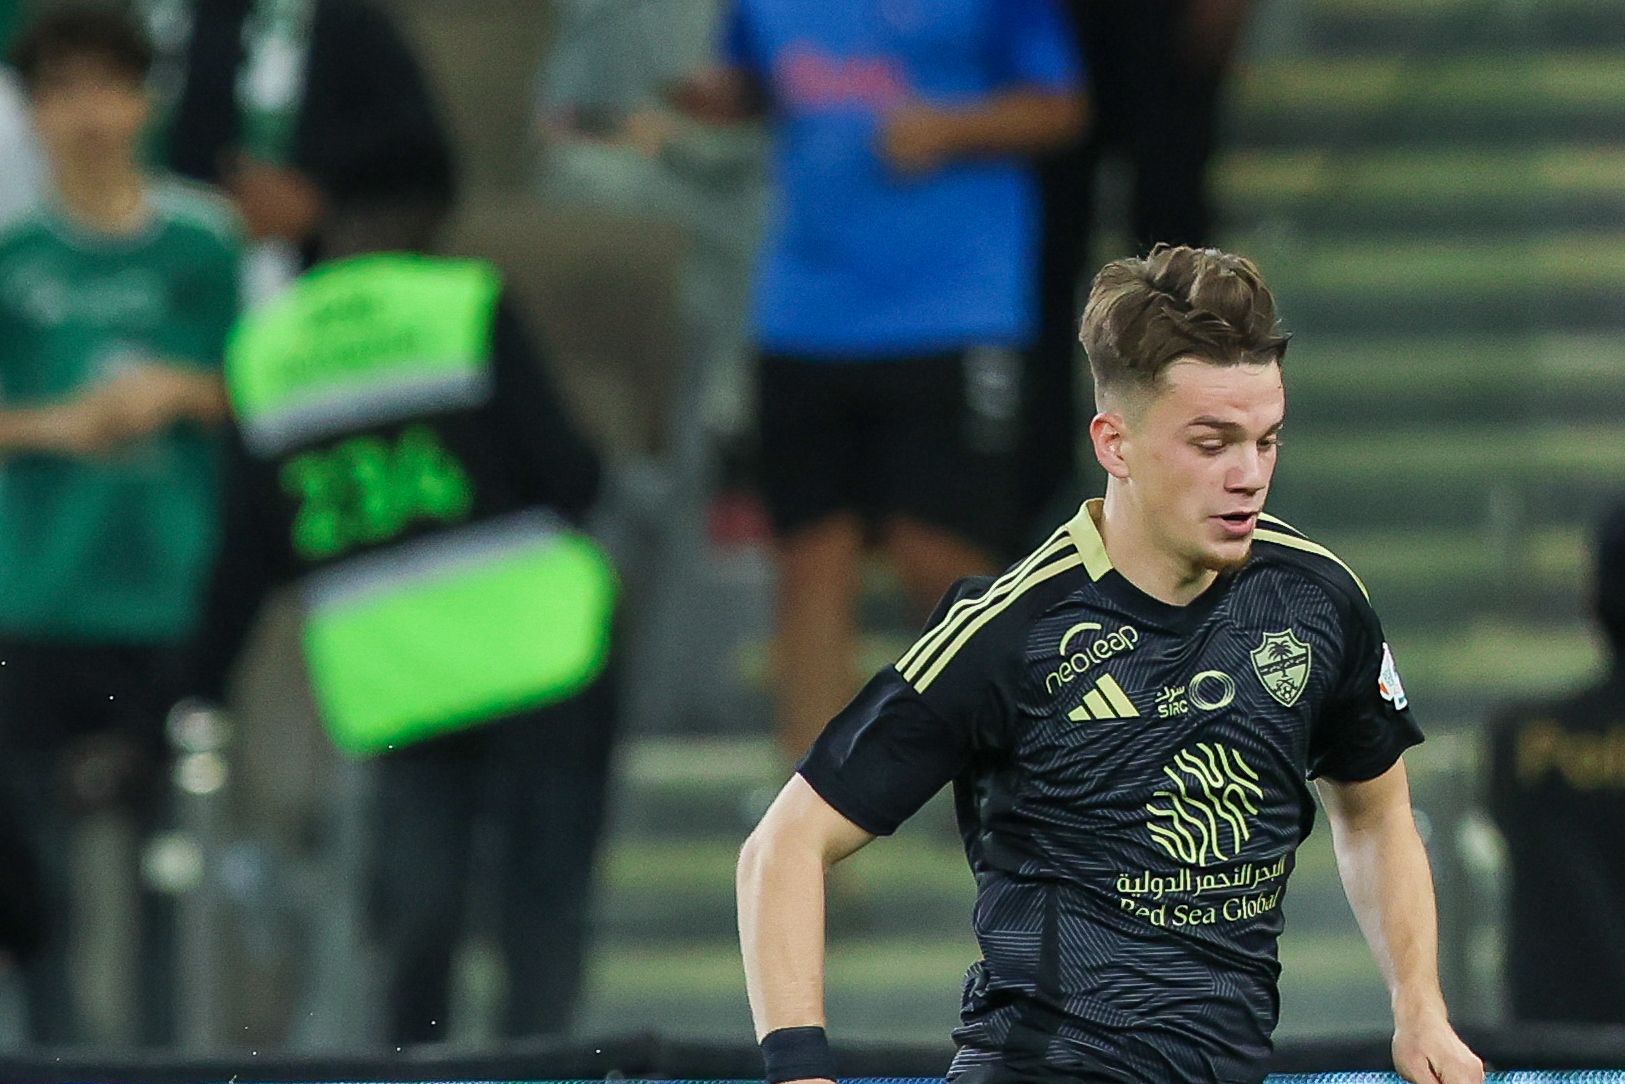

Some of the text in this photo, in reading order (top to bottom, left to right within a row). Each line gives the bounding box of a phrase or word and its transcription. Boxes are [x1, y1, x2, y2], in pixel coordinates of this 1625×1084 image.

[1046, 625, 1138, 694] neoleap
[1158, 700, 1188, 718] SIRC
[1116, 868, 1192, 900] الدولية
[1250, 854, 1287, 889] البحر
[1172, 904, 1216, 927] Sea
[1222, 886, 1282, 921] Global
